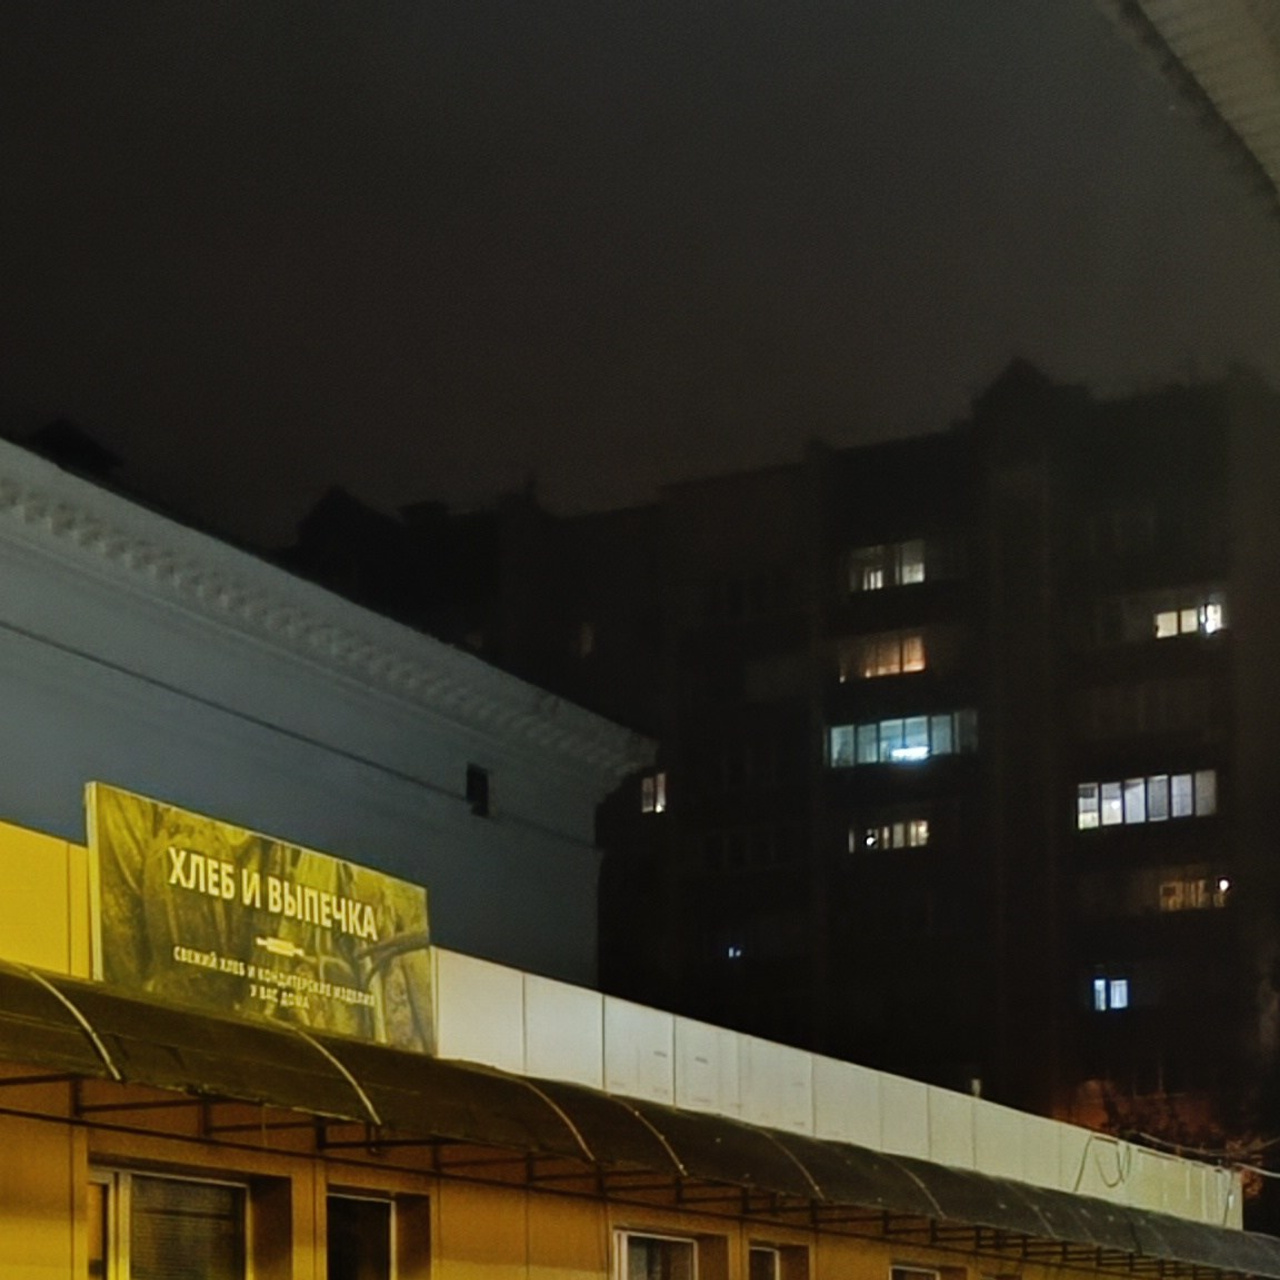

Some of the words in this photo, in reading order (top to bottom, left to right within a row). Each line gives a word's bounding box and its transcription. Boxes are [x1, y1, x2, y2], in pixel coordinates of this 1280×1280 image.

[168, 847, 234, 900] ХЛЕБ
[242, 868, 261, 909] И
[268, 877, 378, 942] ВЫПЕЧКА
[173, 946, 218, 969] СВЕЖИЙ
[220, 958, 246, 976] ХЛЕБ
[247, 965, 256, 978] И
